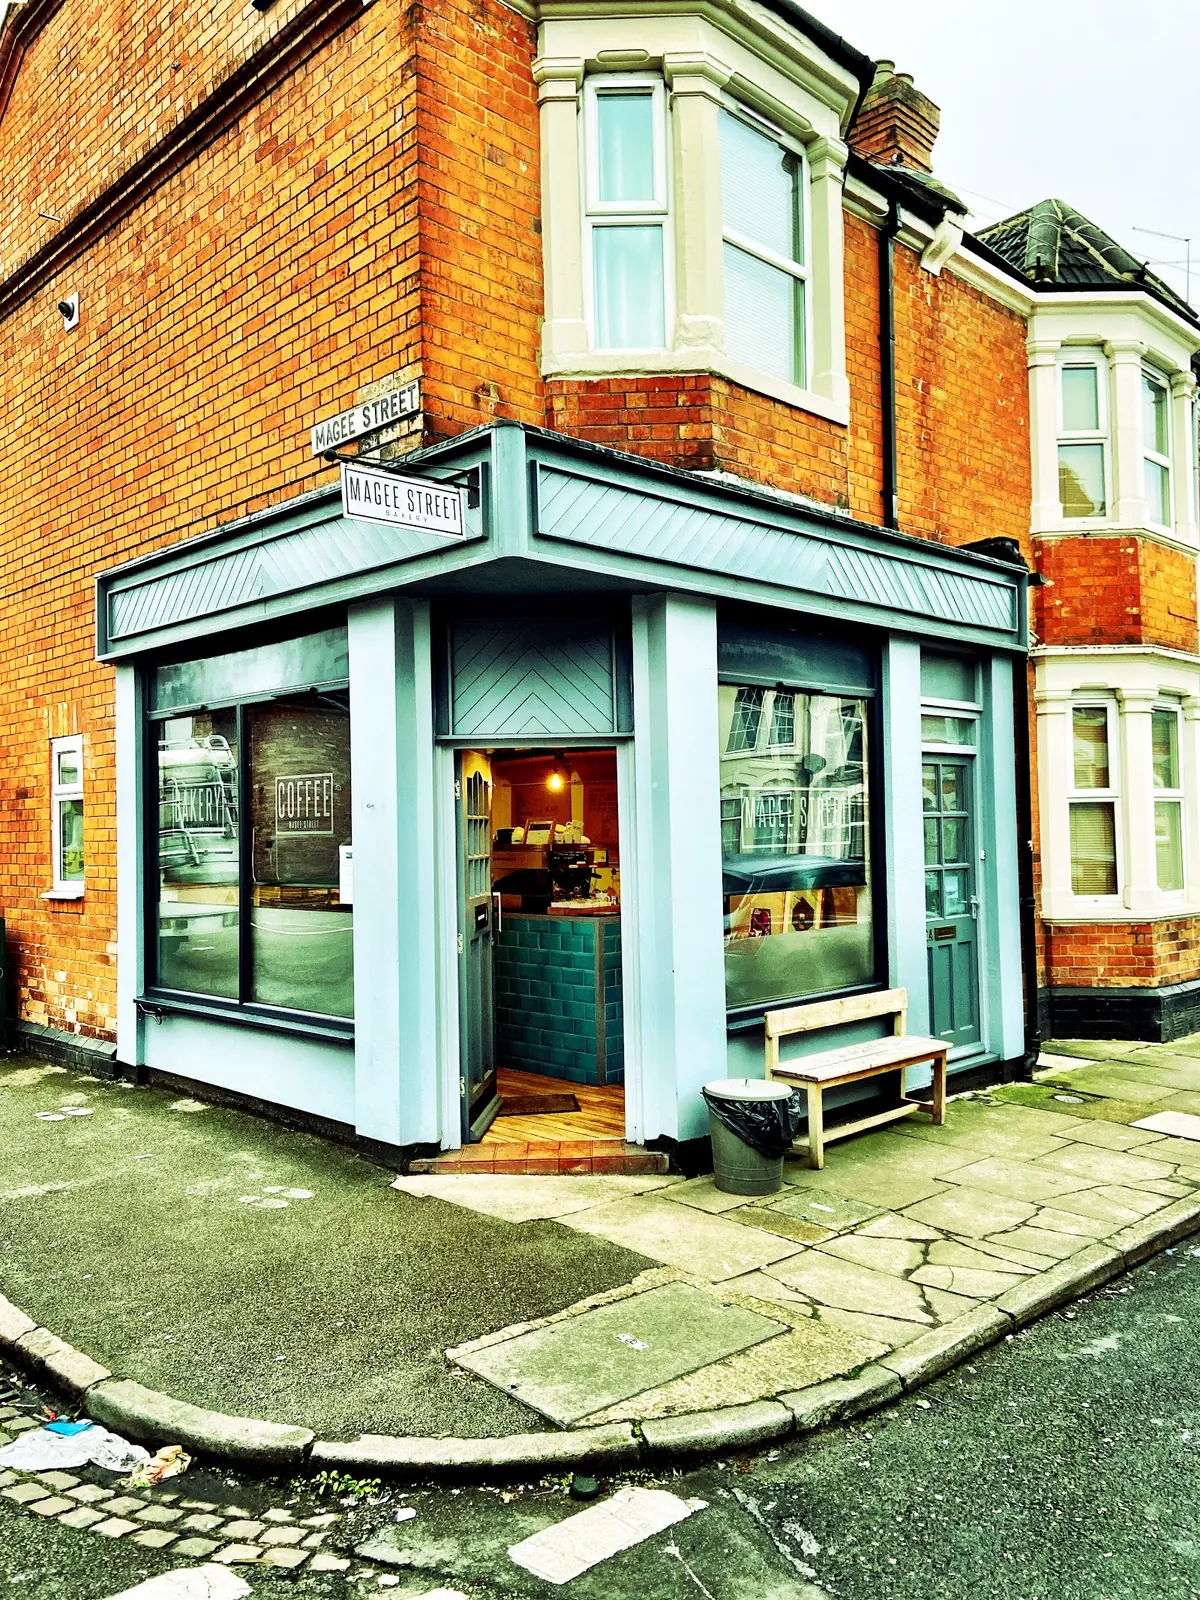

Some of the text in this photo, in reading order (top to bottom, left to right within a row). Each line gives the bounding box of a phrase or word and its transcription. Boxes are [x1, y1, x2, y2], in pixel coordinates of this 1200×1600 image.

[315, 384, 417, 450] MAGEE STREET
[349, 476, 457, 521] MAGEE STREET
[385, 509, 428, 523] BAKERY
[174, 786, 221, 823] BAKERY
[278, 779, 330, 819] COFFEE
[745, 796, 848, 829] MAGEE STREET
